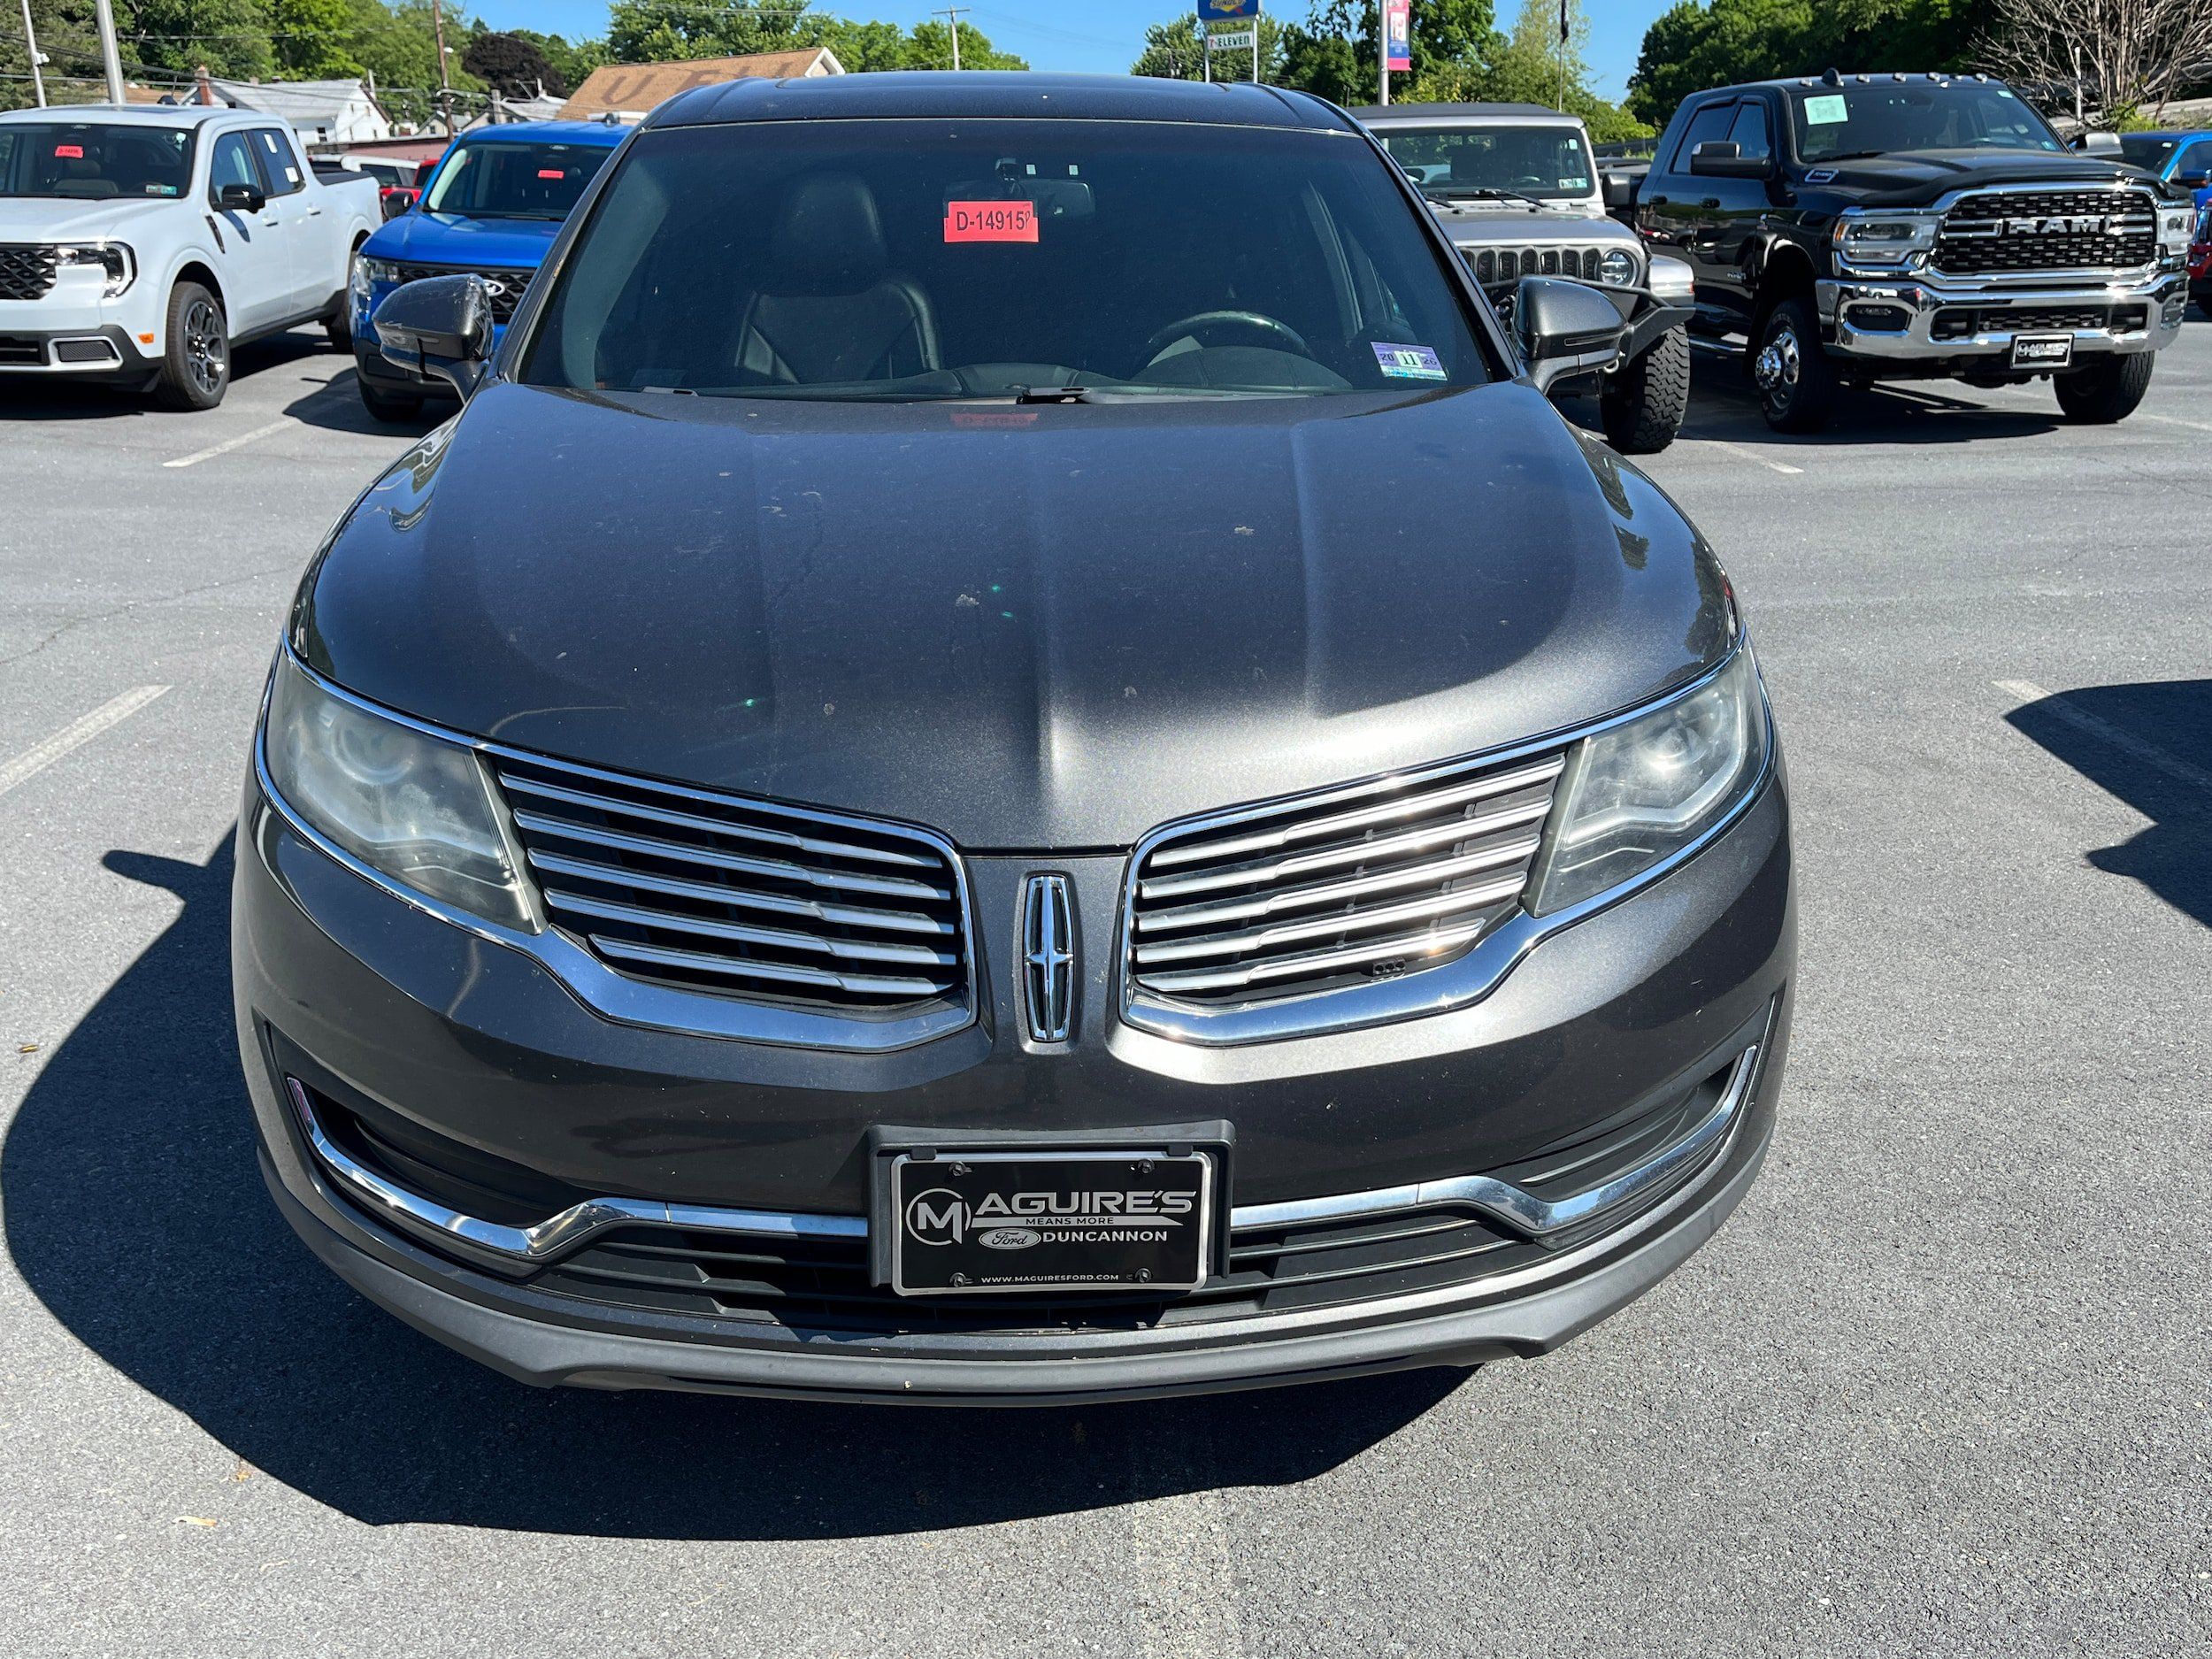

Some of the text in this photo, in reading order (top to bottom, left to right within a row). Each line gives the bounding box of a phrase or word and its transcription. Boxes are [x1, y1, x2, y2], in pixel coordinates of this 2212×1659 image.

[2008, 217, 2102, 234] RAM
[1401, 353, 1418, 365] 11
[991, 1231, 1167, 1245] Ford DUNCANNON
[981, 1274, 1119, 1283] WWW.MAGUIRESFORD.COM
